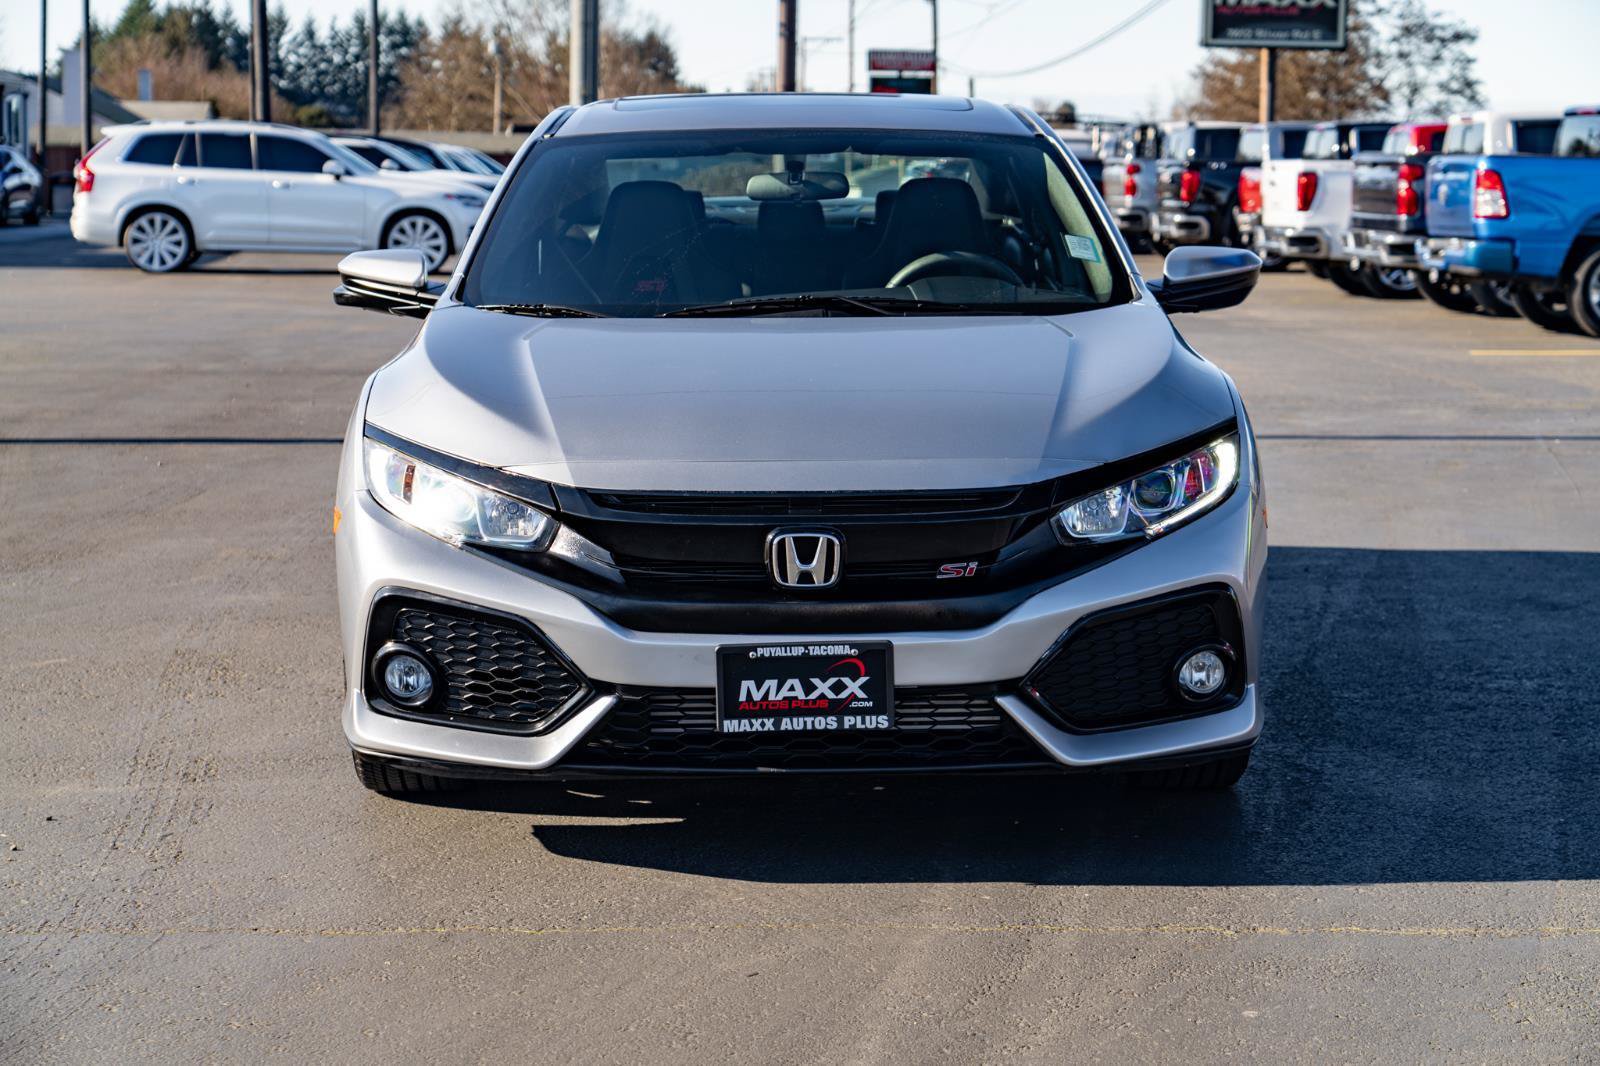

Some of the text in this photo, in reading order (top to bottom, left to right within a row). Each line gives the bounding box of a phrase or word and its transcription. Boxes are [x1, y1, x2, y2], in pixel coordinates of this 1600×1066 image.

[936, 561, 978, 579] Si
[738, 676, 872, 702] MAXX
[738, 699, 829, 710] AUTOS PLUS
[723, 715, 889, 733] MAXX AUTOS PLUS
